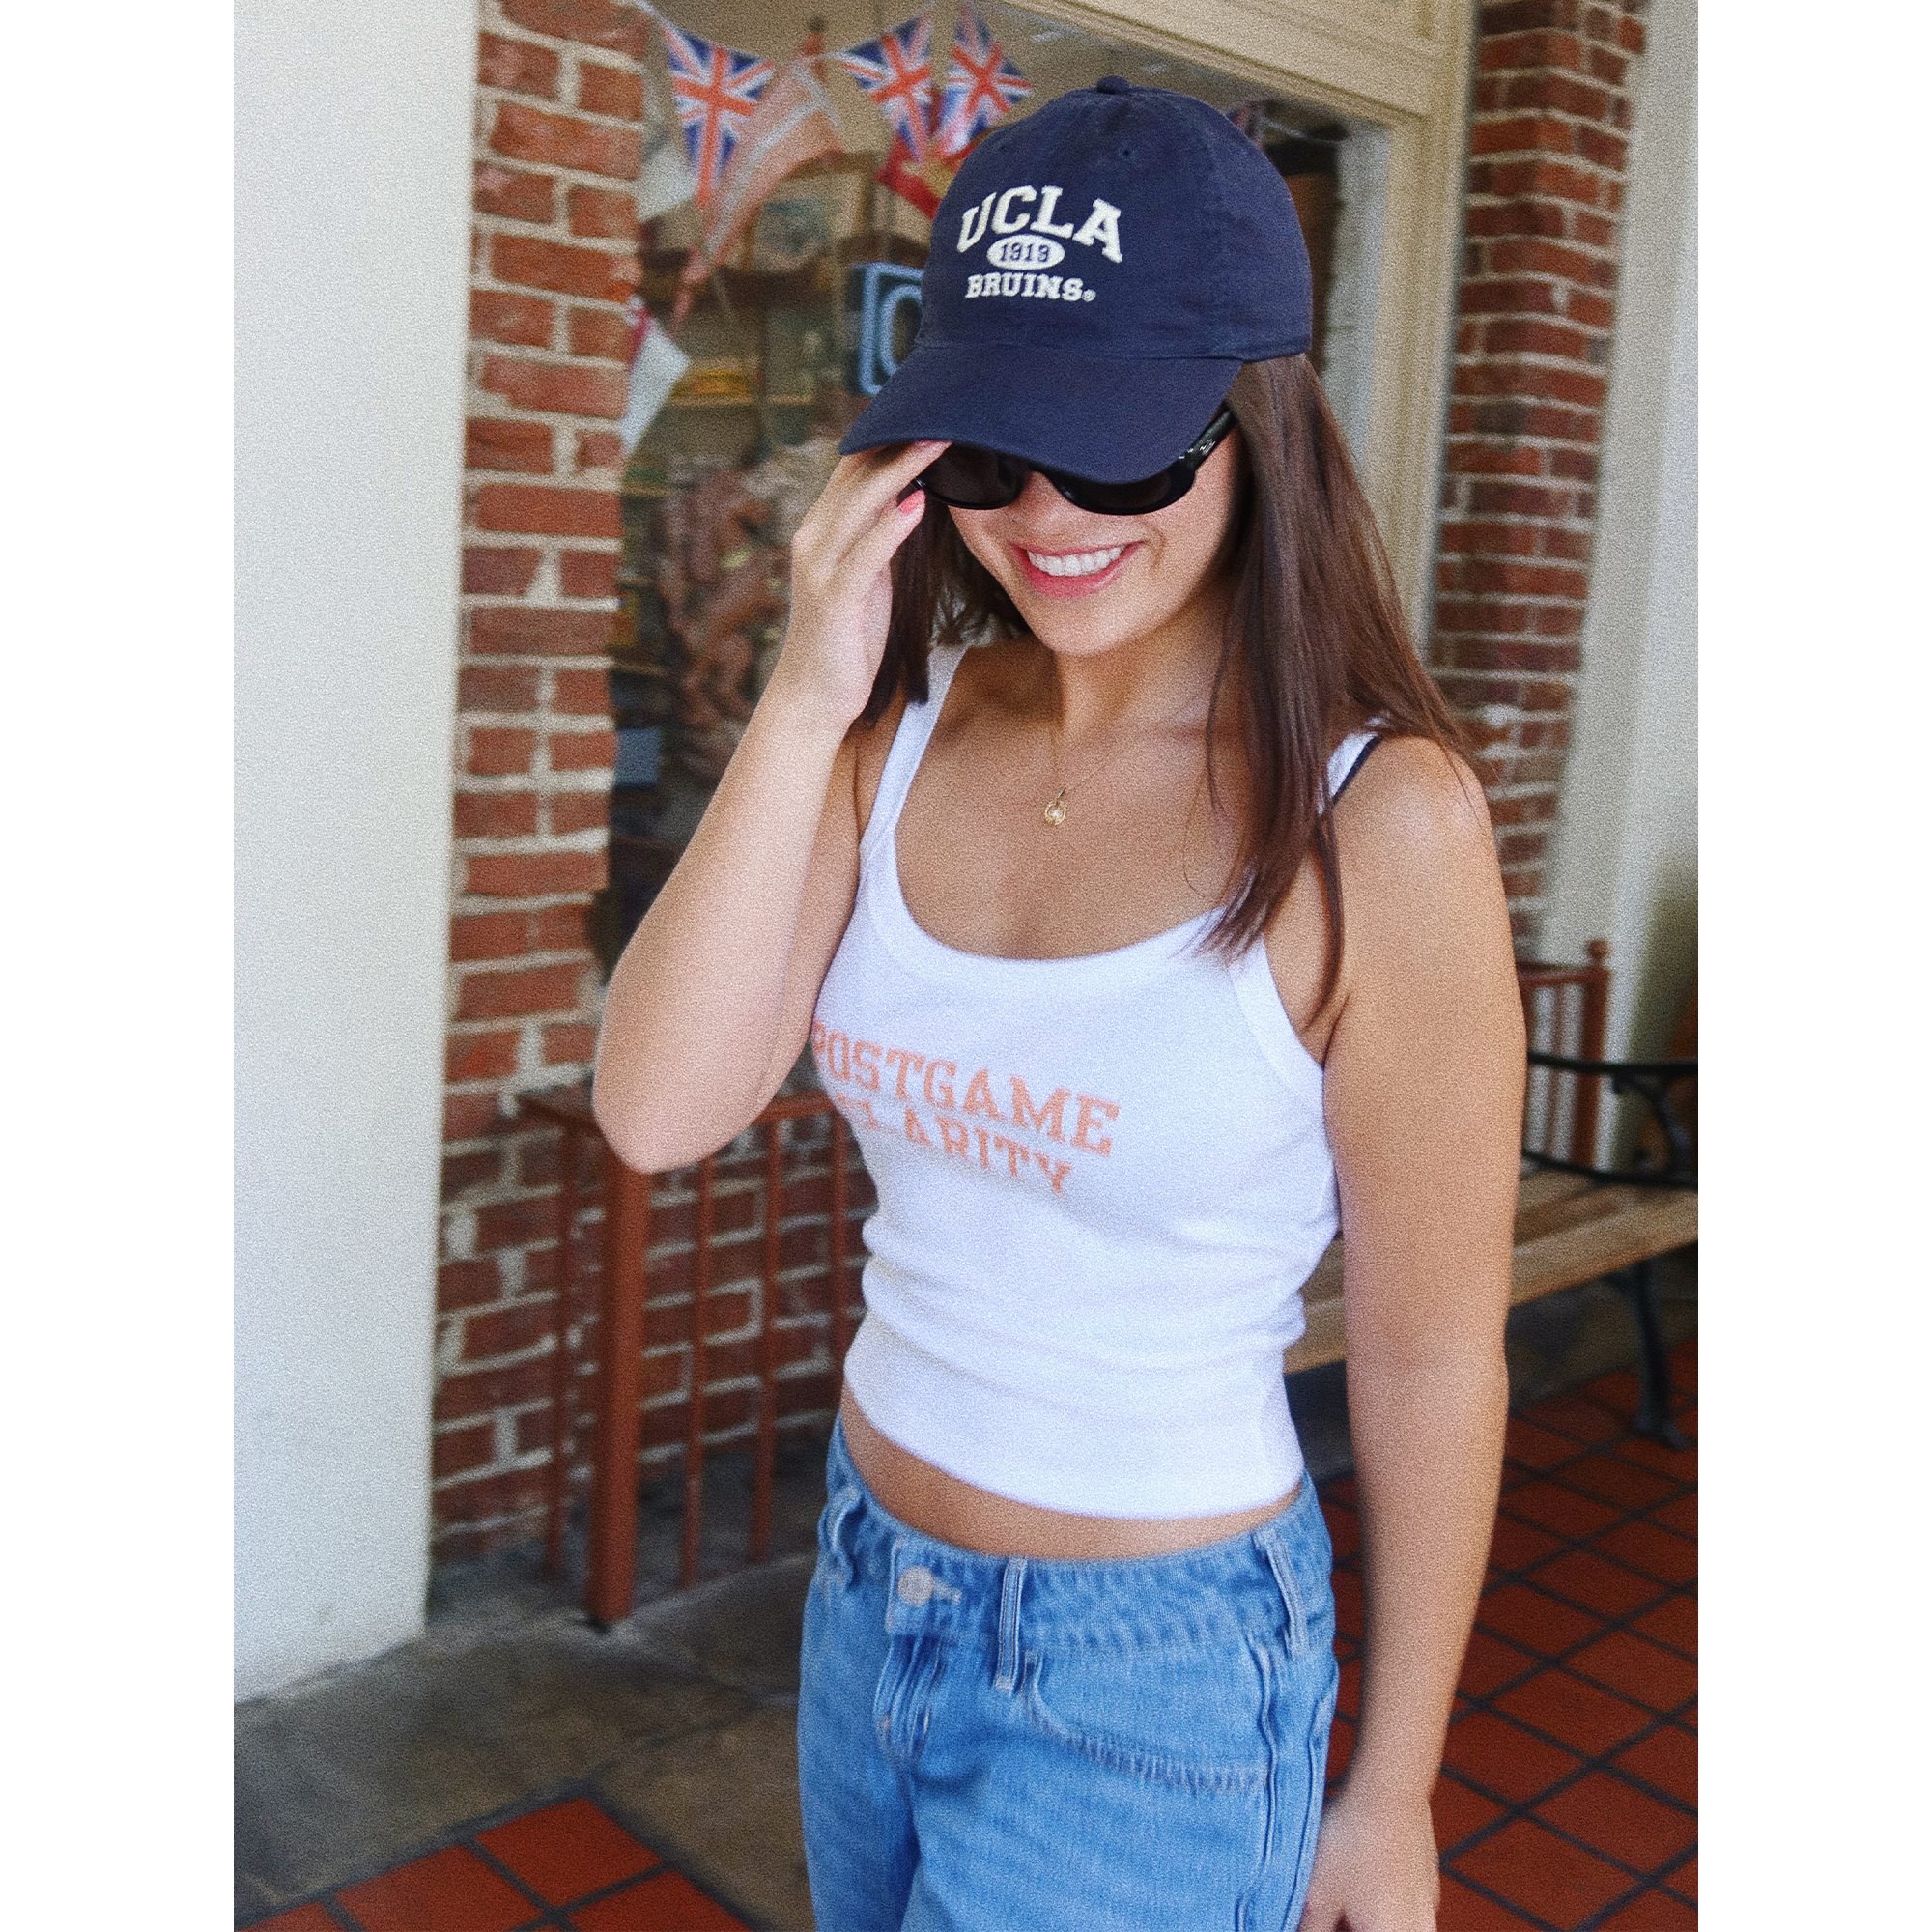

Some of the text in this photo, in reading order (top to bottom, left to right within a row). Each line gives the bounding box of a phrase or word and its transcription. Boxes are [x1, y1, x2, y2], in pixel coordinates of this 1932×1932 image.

[956, 185, 1123, 264] UCLA
[999, 243, 1050, 263] 1919
[834, 1093, 1072, 1195] LARITY
